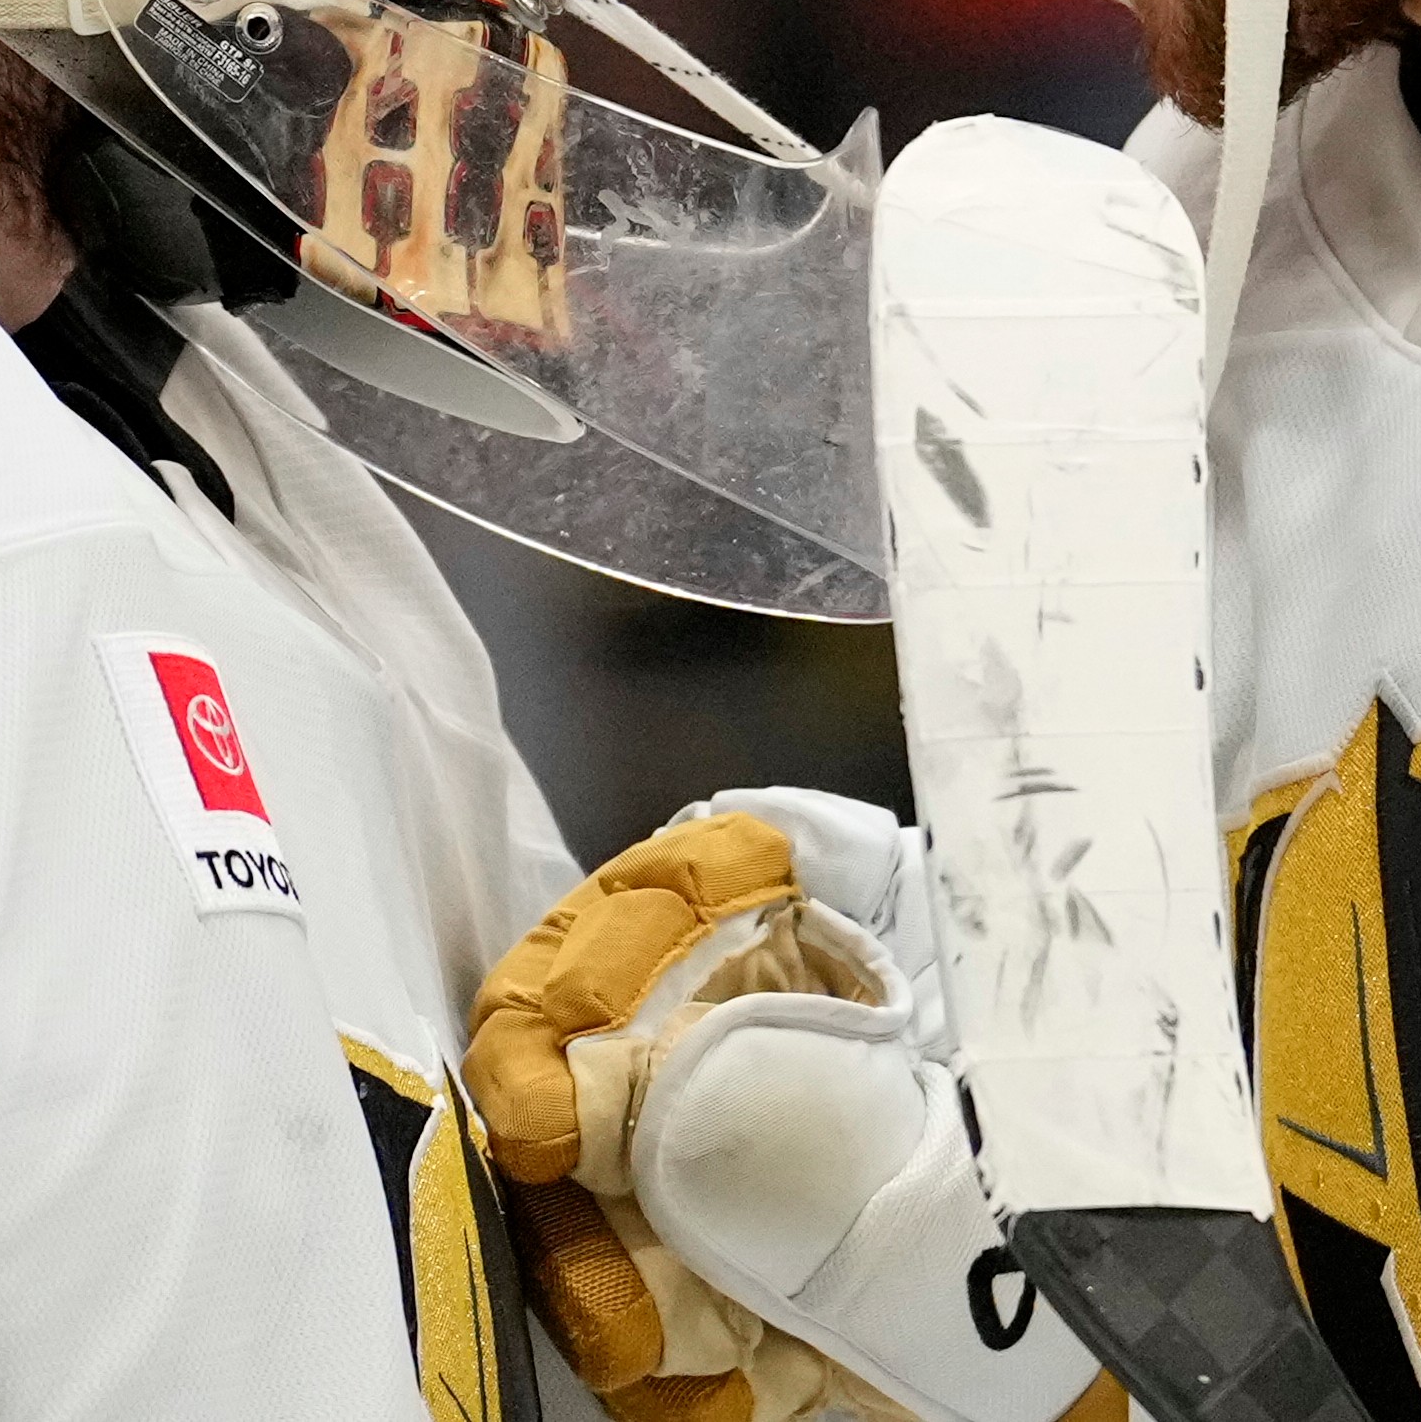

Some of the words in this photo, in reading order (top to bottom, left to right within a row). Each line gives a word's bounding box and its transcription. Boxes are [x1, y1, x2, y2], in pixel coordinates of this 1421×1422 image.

[158, 27, 186, 50] MADE
[185, 47, 196, 59] IN
[196, 57, 225, 81] CHINA
[219, 40, 243, 59] GTP
